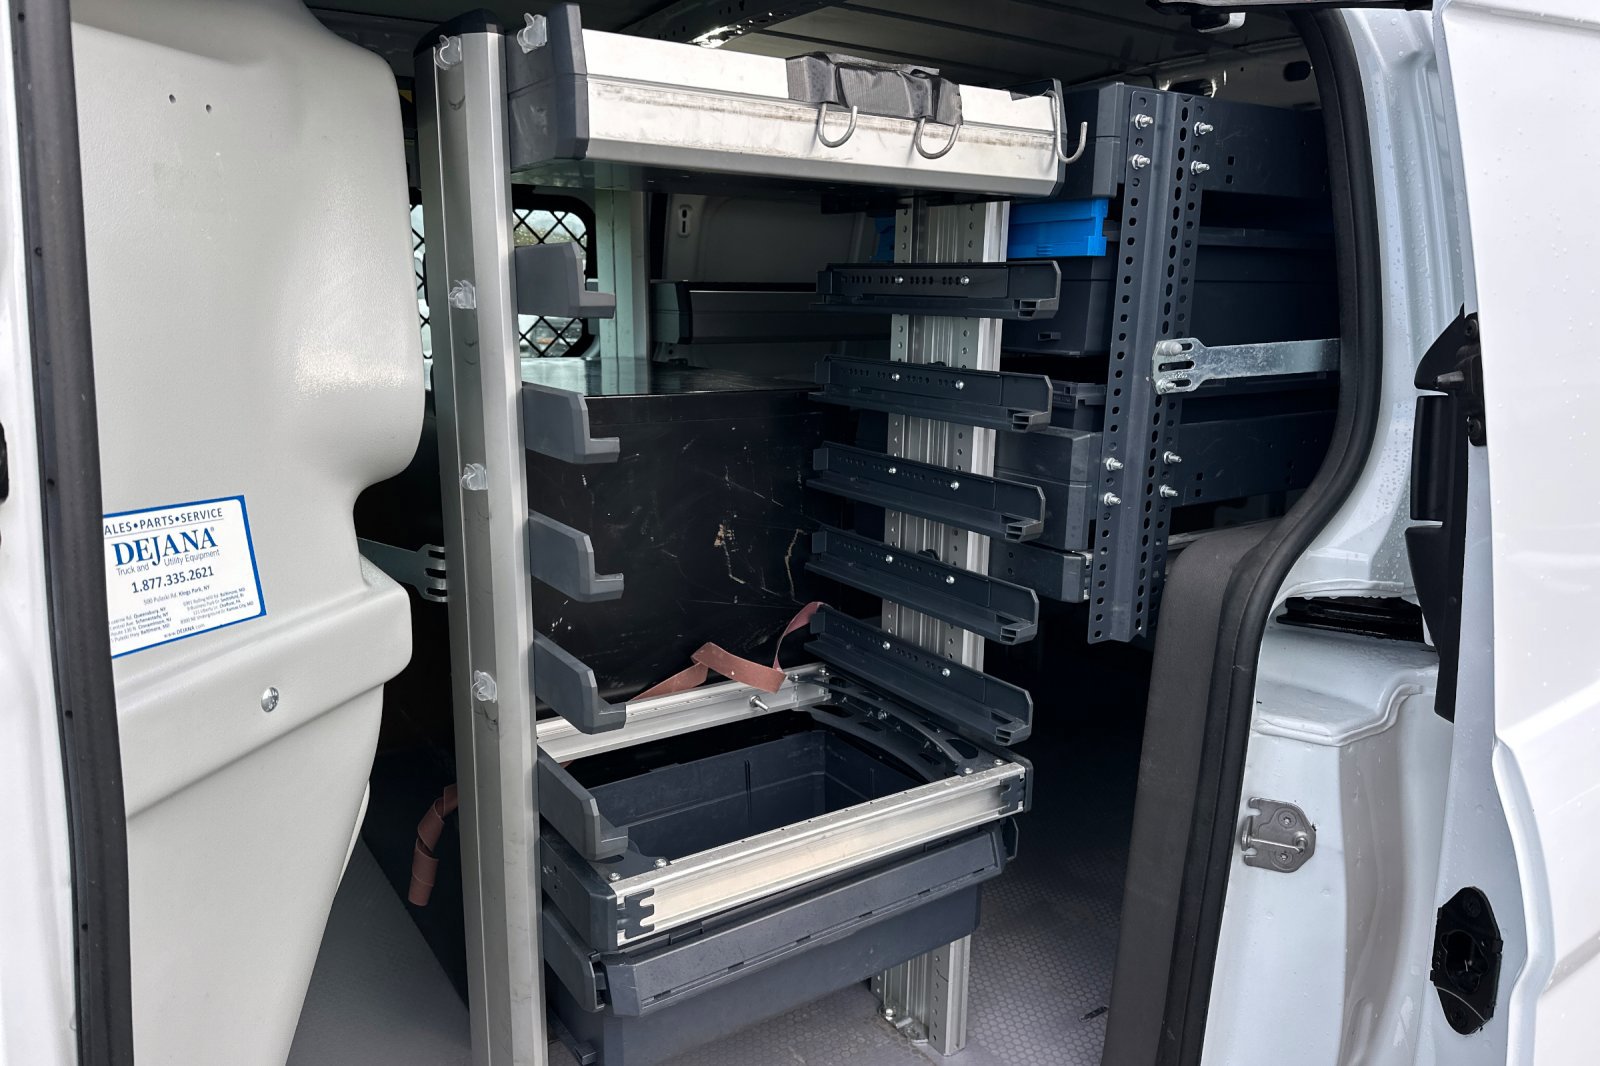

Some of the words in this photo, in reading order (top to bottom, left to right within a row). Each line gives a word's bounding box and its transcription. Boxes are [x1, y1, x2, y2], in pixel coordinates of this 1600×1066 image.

[104, 521, 132, 536] ALES
[140, 514, 174, 530] PARTS
[180, 508, 223, 523] SERVICE
[111, 527, 218, 567] DEJANA
[116, 564, 136, 576] Truck
[137, 563, 150, 573] and
[163, 554, 184, 567] Utility
[185, 549, 221, 563] Equipment
[131, 565, 215, 593] 1.877.335.2621
